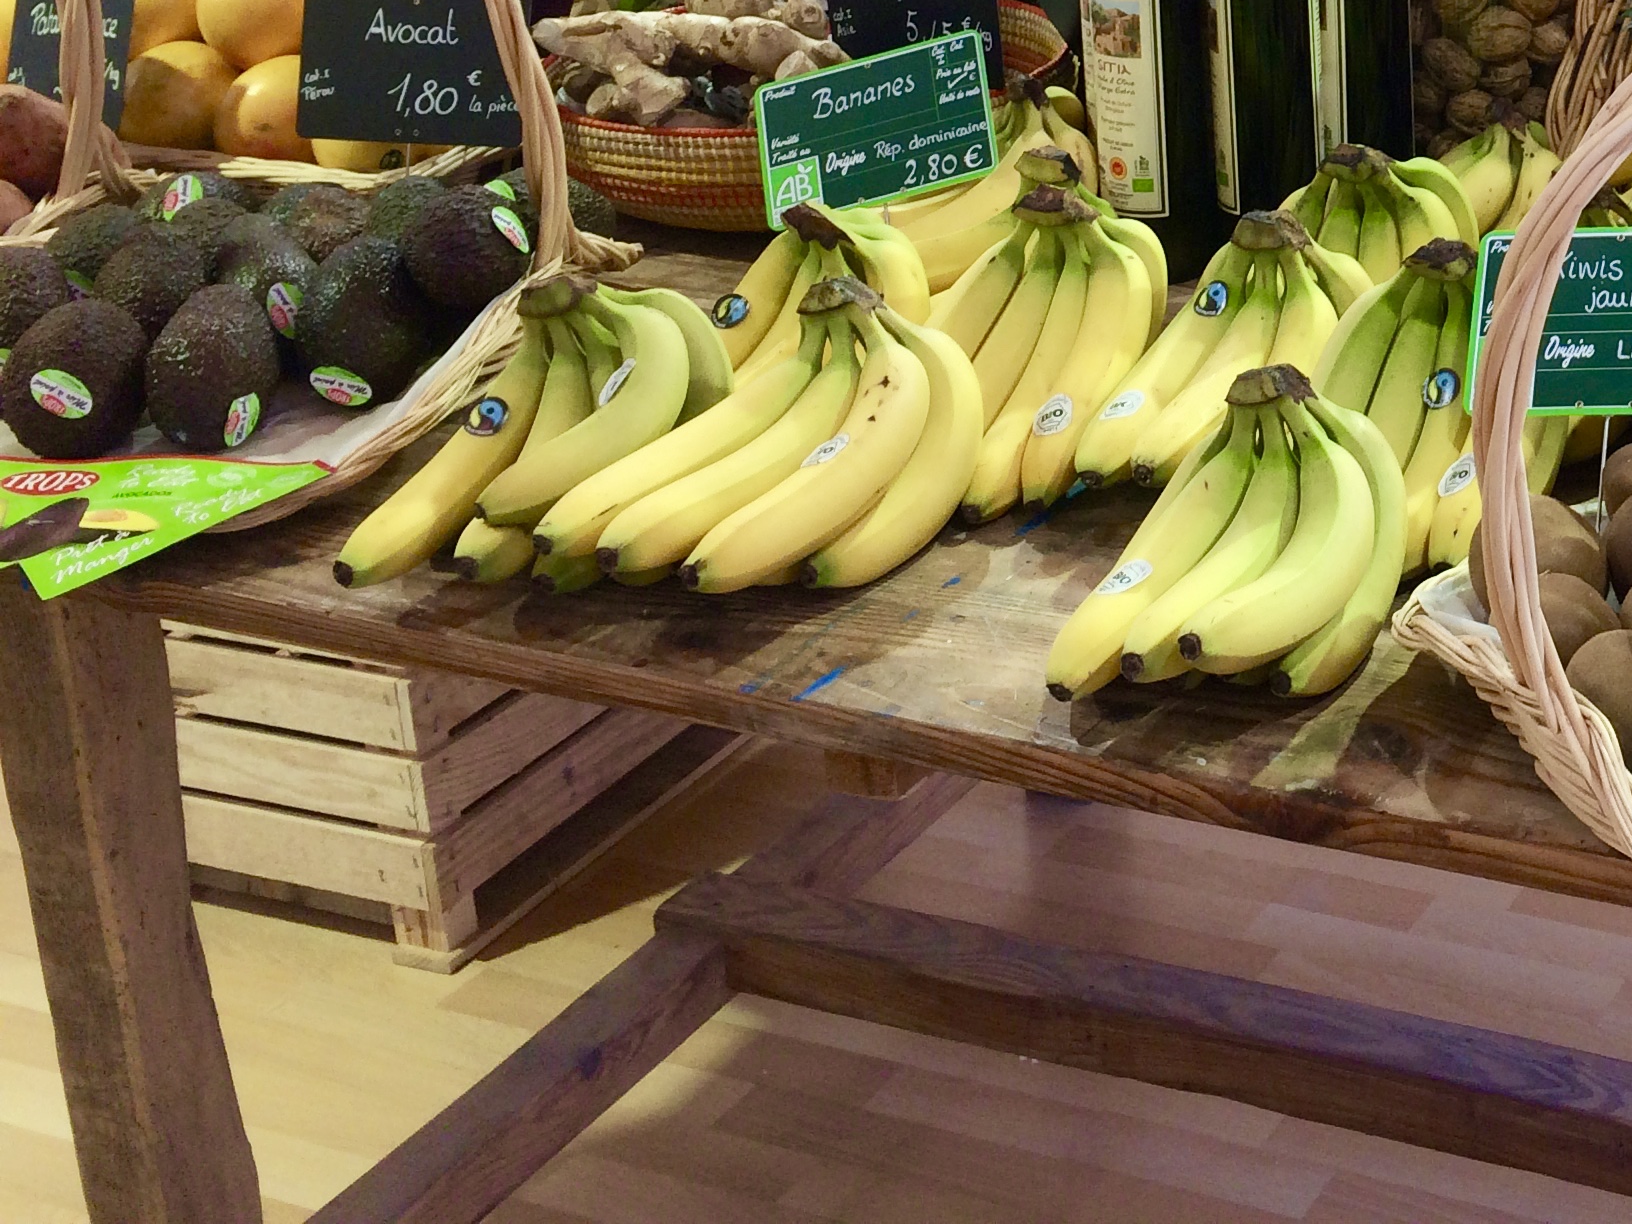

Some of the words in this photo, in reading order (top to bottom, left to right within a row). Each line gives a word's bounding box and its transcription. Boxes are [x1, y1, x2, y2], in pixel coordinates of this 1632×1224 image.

[365, 8, 459, 45] Avocat
[969, 72, 976, 80] €
[387, 73, 458, 117] 1,80
[467, 70, 482, 86] €
[469, 95, 482, 112] la
[764, 85, 796, 102] Produit
[812, 74, 915, 119] Bananes
[771, 133, 799, 150] Variété
[826, 150, 866, 176] Origine
[909, 121, 988, 151] dominicaine
[903, 154, 957, 186] 2,80
[963, 144, 984, 168] €
[776, 174, 814, 207] AB
[1544, 335, 1595, 367] Origine
[4, 471, 96, 490] TROPS
[51, 537, 155, 584] Manger
